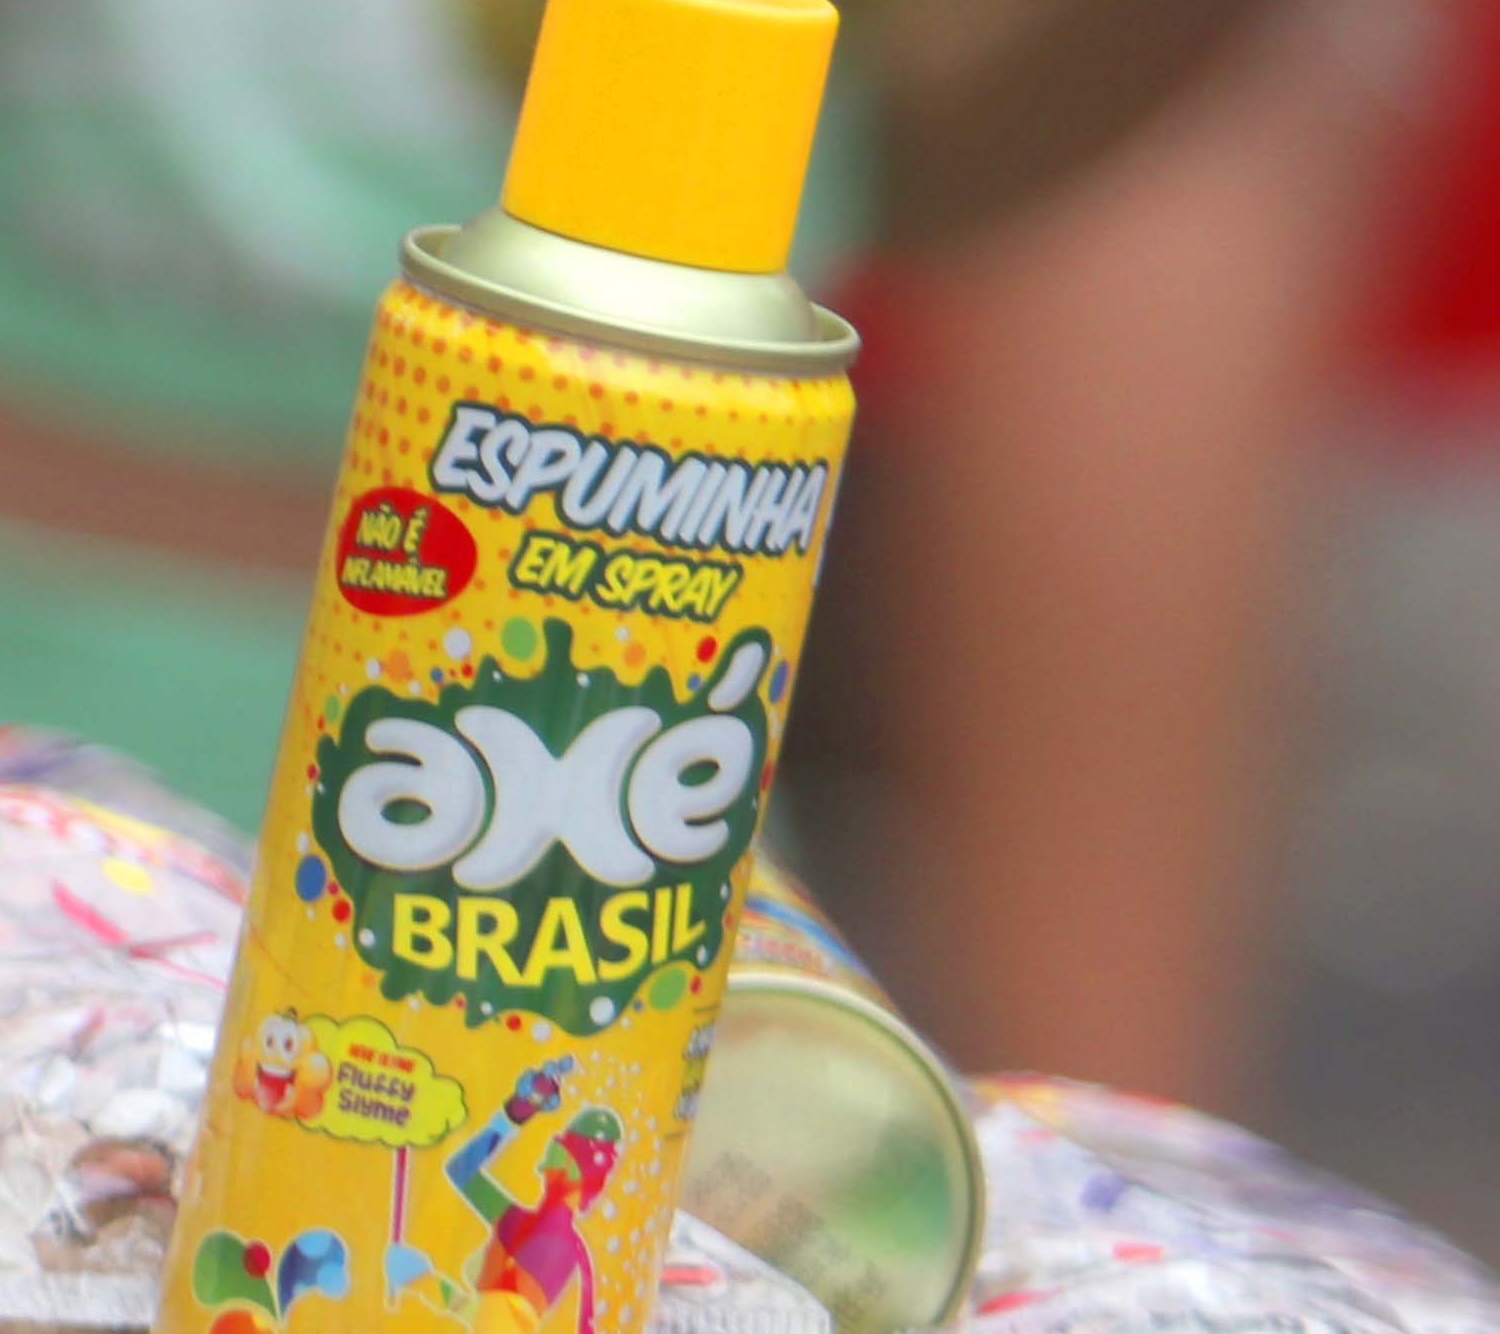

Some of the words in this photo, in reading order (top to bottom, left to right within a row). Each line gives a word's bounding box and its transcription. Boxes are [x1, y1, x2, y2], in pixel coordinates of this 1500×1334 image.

[431, 405, 828, 553] ESPUMINHA
[516, 535, 594, 593] EM
[596, 555, 740, 619] SPRAY
[336, 641, 765, 891] axé
[391, 883, 706, 987] BRASIL
